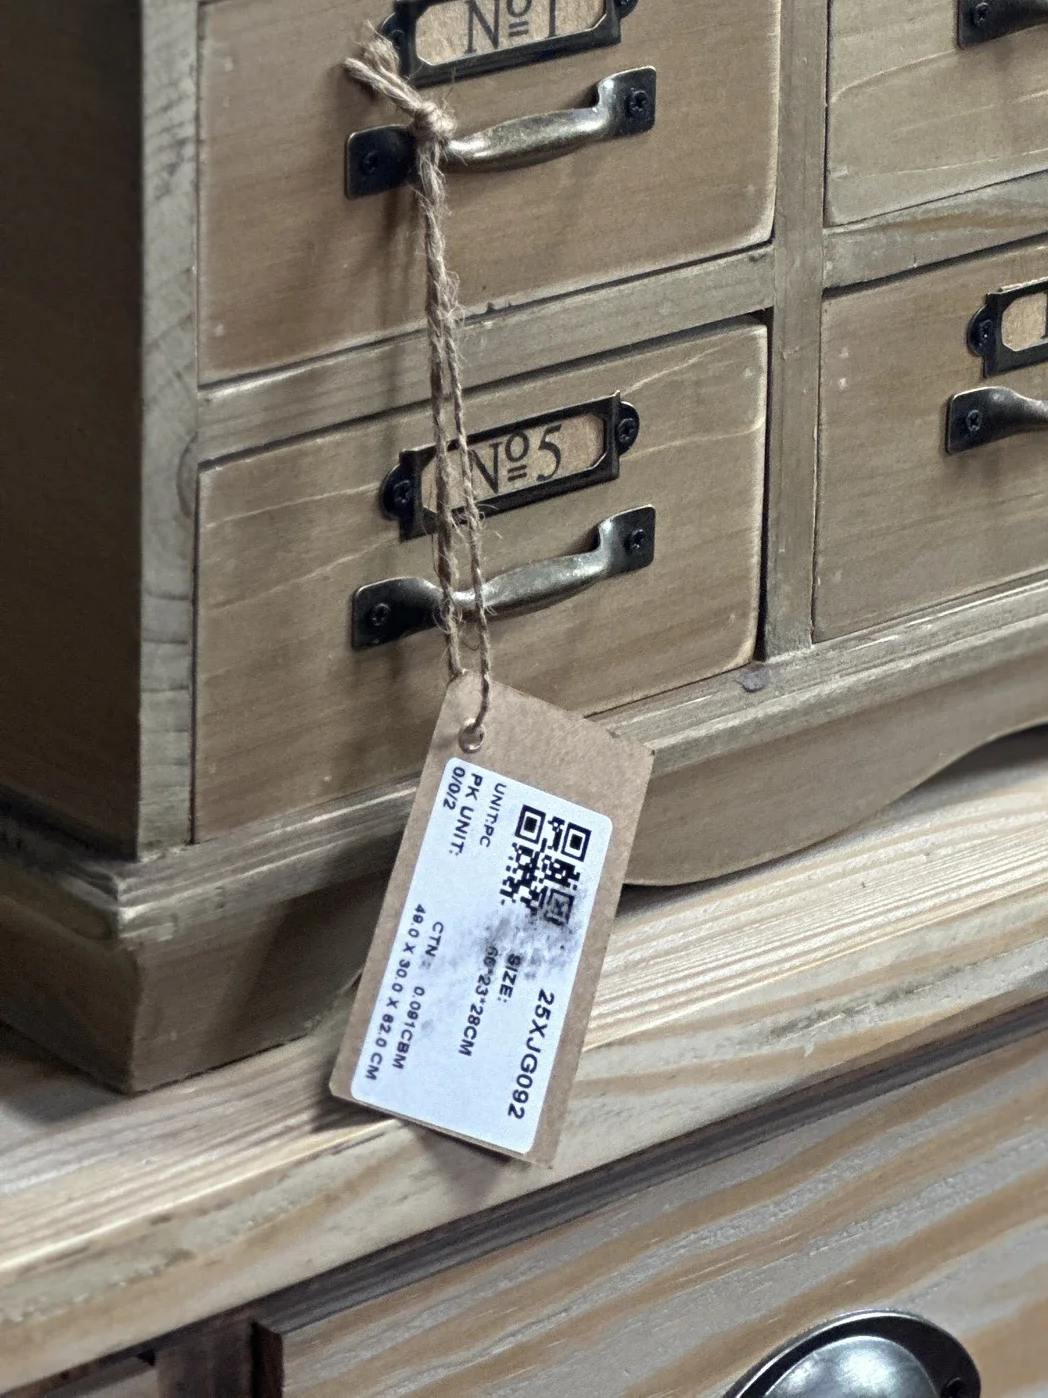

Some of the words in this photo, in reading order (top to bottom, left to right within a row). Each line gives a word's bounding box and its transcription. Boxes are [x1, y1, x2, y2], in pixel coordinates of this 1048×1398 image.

[441, 765, 466, 811] 0/0/2
[464, 772, 484, 801] PK
[448, 804, 474, 856] UNIT:
[401, 941, 416, 954] X
[390, 958, 411, 993] 30.0
[496, 951, 525, 1003] SIZE:
[385, 996, 400, 1009] X
[364, 1051, 383, 1081] CM
[506, 987, 555, 1120] 25XJG092
